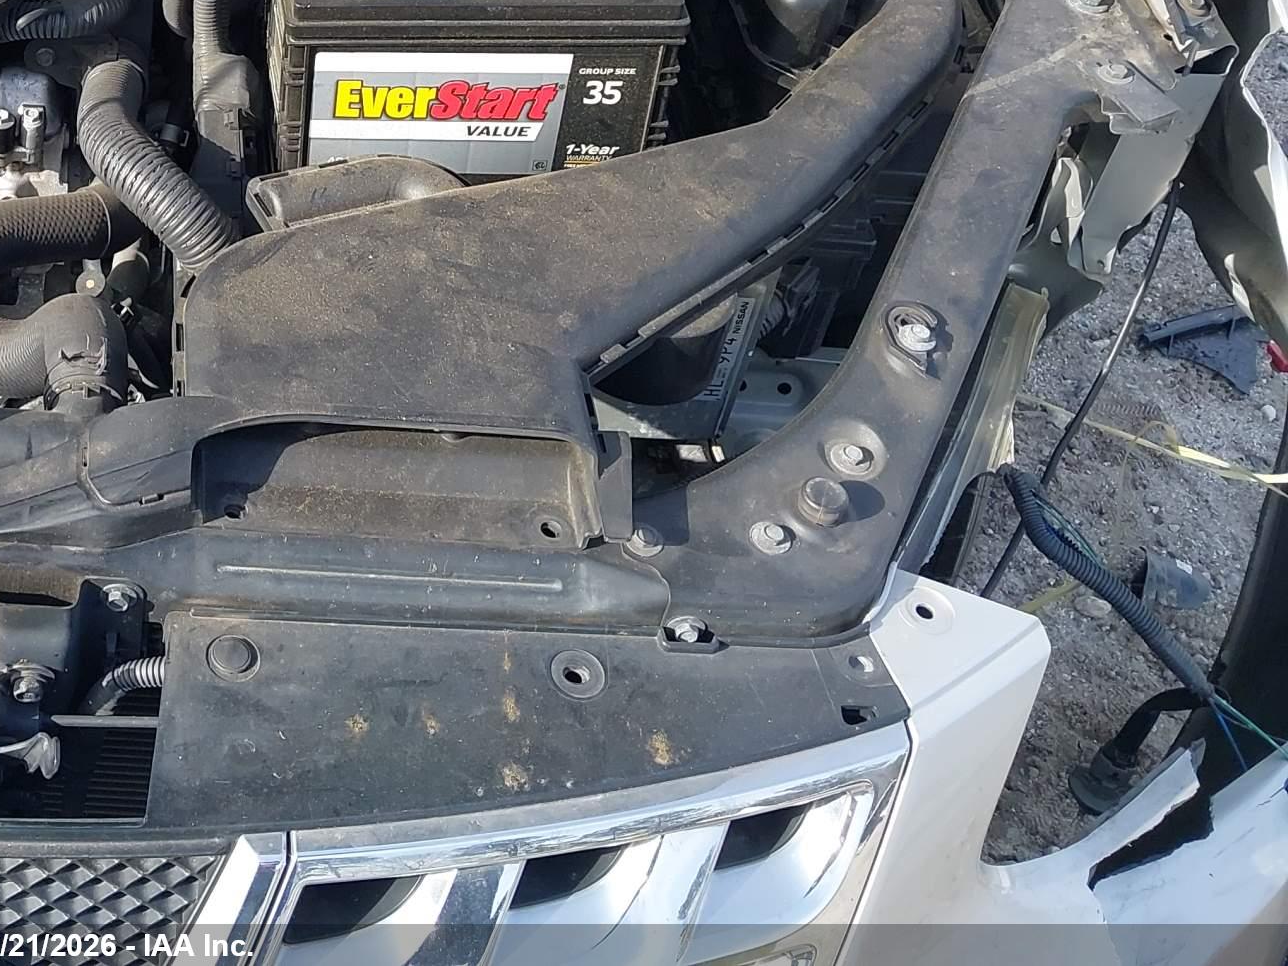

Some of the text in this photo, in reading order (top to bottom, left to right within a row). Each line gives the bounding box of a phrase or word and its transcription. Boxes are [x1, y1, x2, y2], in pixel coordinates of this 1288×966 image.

[333, 79, 559, 121] EverStart
[583, 80, 623, 105] 35
[466, 125, 532, 137] VALUE
[566, 143, 620, 155] 1-Year
[733, 301, 750, 334] NISSAN
